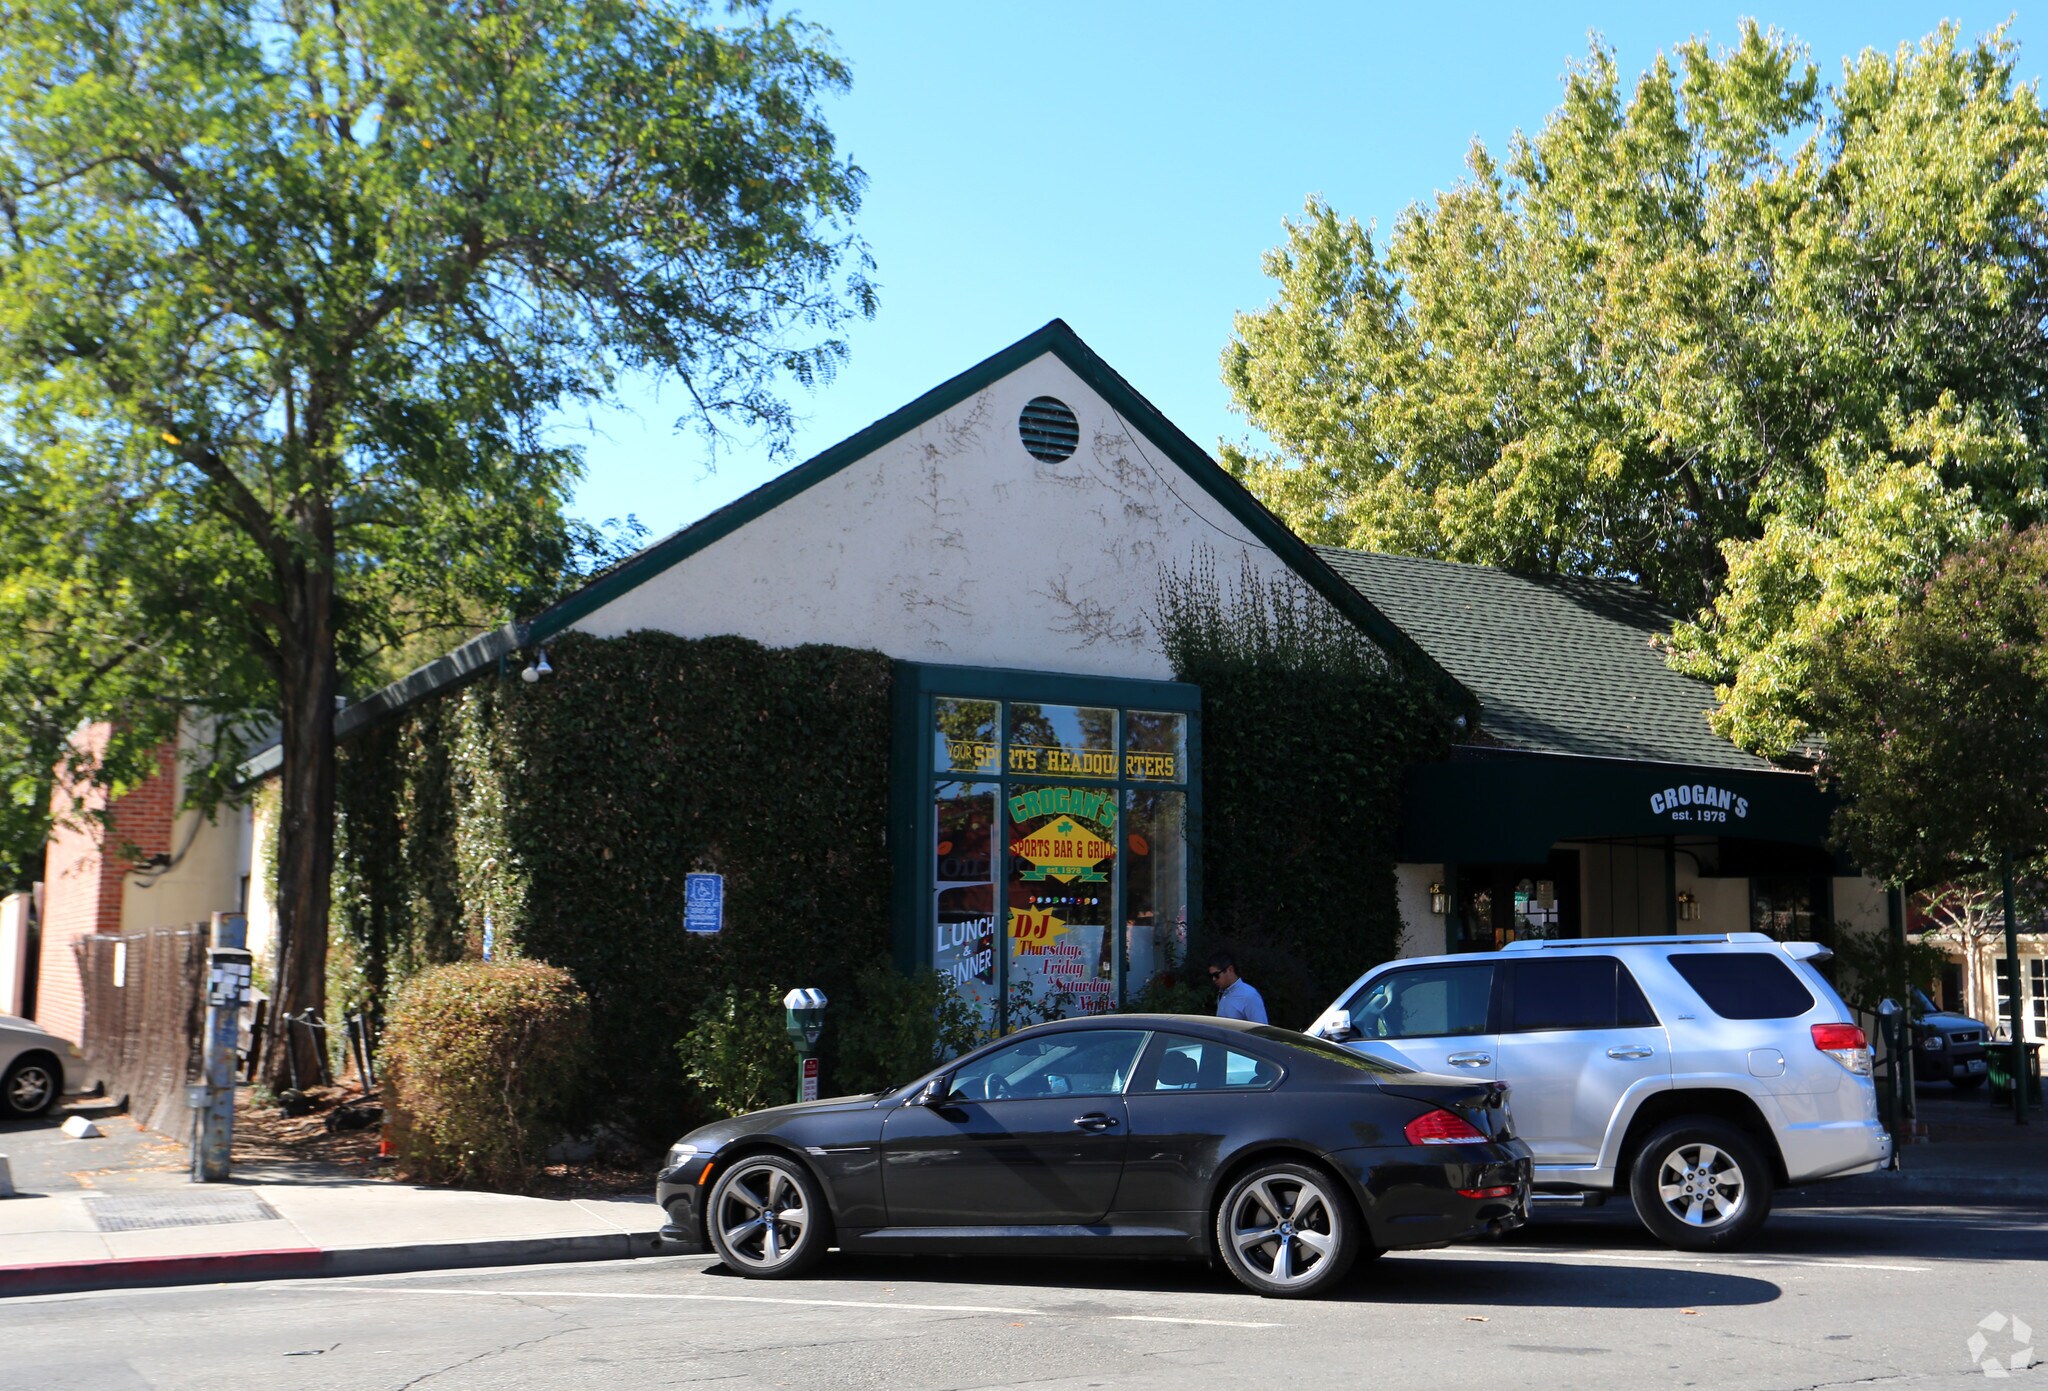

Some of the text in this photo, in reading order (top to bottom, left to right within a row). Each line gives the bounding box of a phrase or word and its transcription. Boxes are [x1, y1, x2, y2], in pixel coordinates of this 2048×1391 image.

[1008, 787, 1119, 829] CROGAN'S
[1650, 784, 1749, 818] CROGAN'S
[1672, 810, 1727, 822] est. 1978
[1010, 839, 1050, 857] SPORTS
[1054, 840, 1073, 858] BAR
[1076, 841, 1083, 858] &
[937, 916, 995, 952] LUNCH
[1014, 914, 1051, 939] DJ
[963, 945, 972, 957] &
[1043, 959, 1084, 978] Friday
[1055, 977, 1111, 996] Saturday
